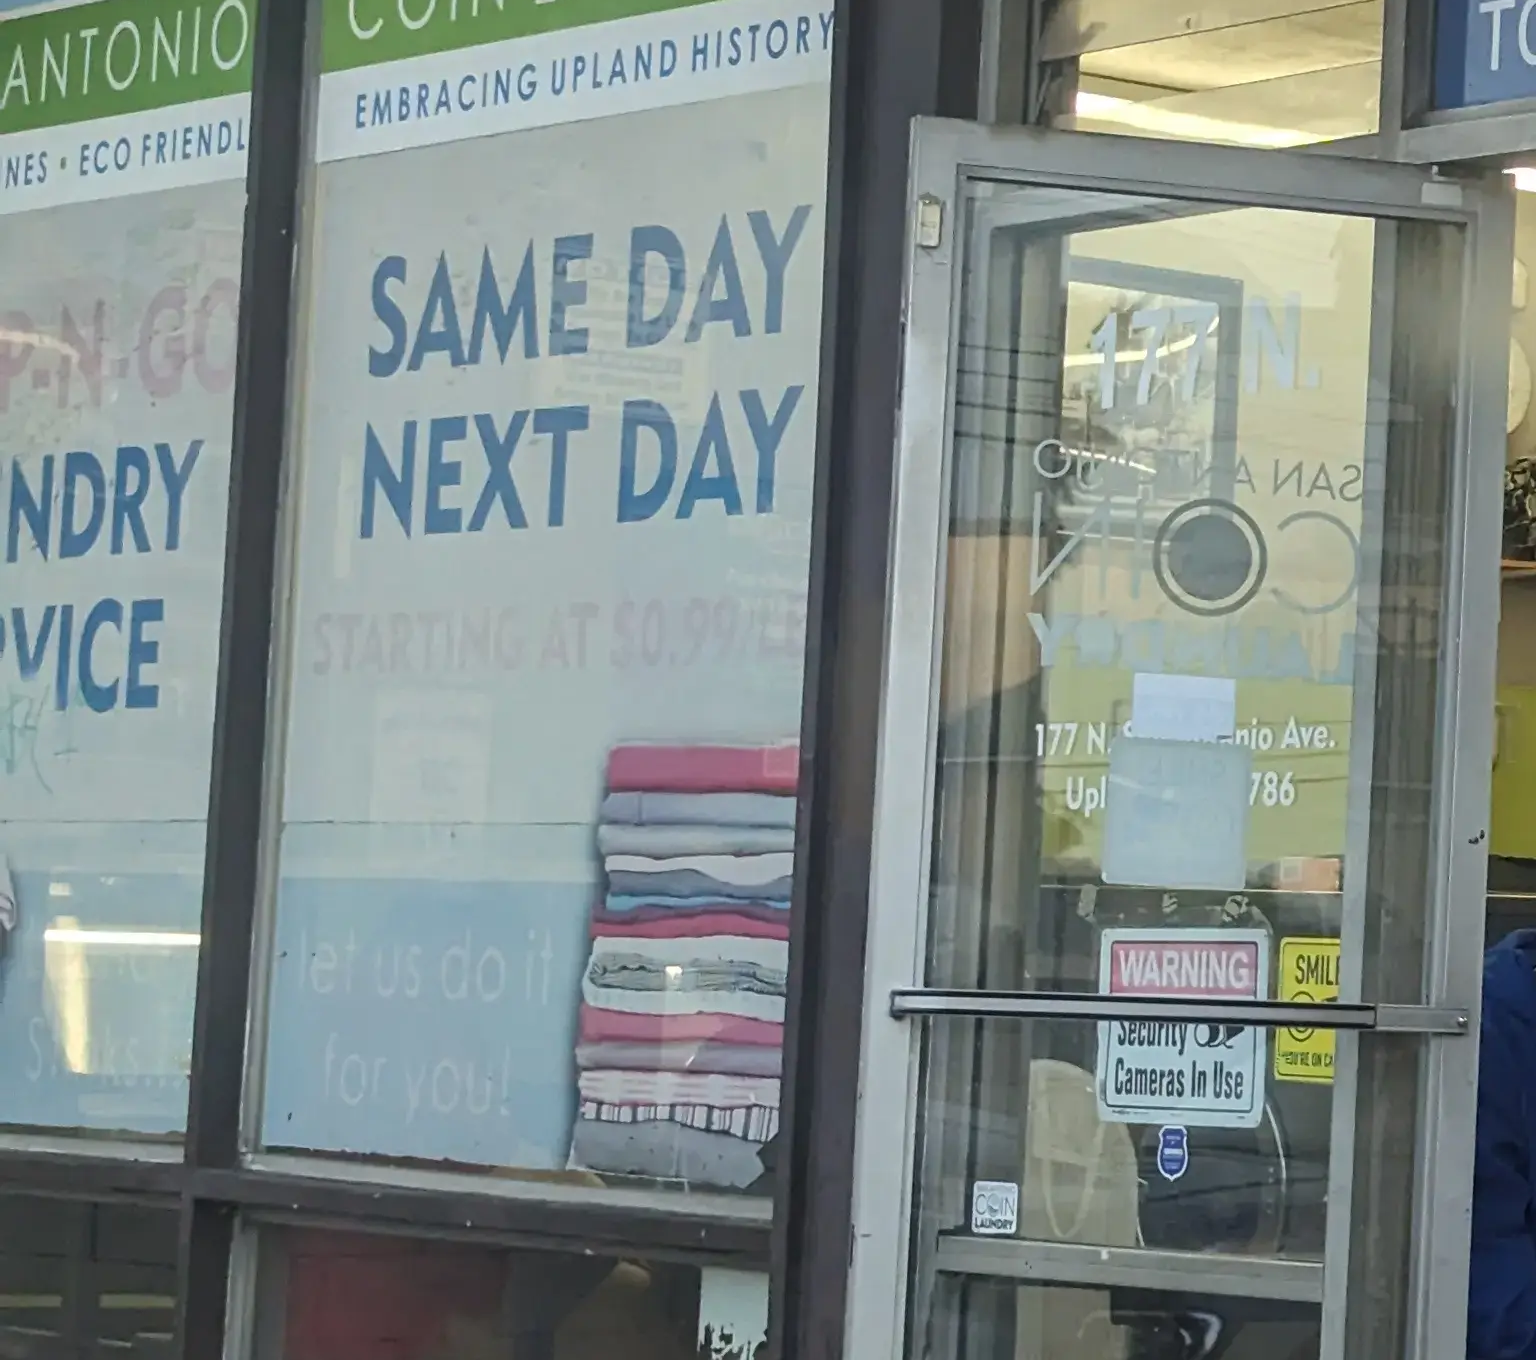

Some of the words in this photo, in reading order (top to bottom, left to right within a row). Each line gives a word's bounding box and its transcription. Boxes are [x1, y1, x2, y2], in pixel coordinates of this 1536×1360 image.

[354, 63, 538, 130] EMBRACING
[550, 39, 678, 97] UPLAND
[691, 10, 834, 74] HISTORY
[4, 150, 48, 189] NES
[79, 137, 132, 177] ECO
[141, 117, 246, 167] FRIENDL
[368, 232, 595, 379] SAME
[626, 204, 814, 349] DAY
[6, 439, 204, 564] NDRY
[360, 404, 590, 541] NEXT
[617, 384, 806, 524] DAY
[0, 597, 165, 714] VICE
[1035, 722, 1078, 757] 177
[1280, 716, 1336, 749] Ave.
[1248, 771, 1296, 806] 786
[1118, 949, 1250, 990] WARNING
[1114, 1057, 1185, 1099] Cameras
[1191, 1060, 1207, 1098] In
[1213, 1061, 1244, 1101] Use
